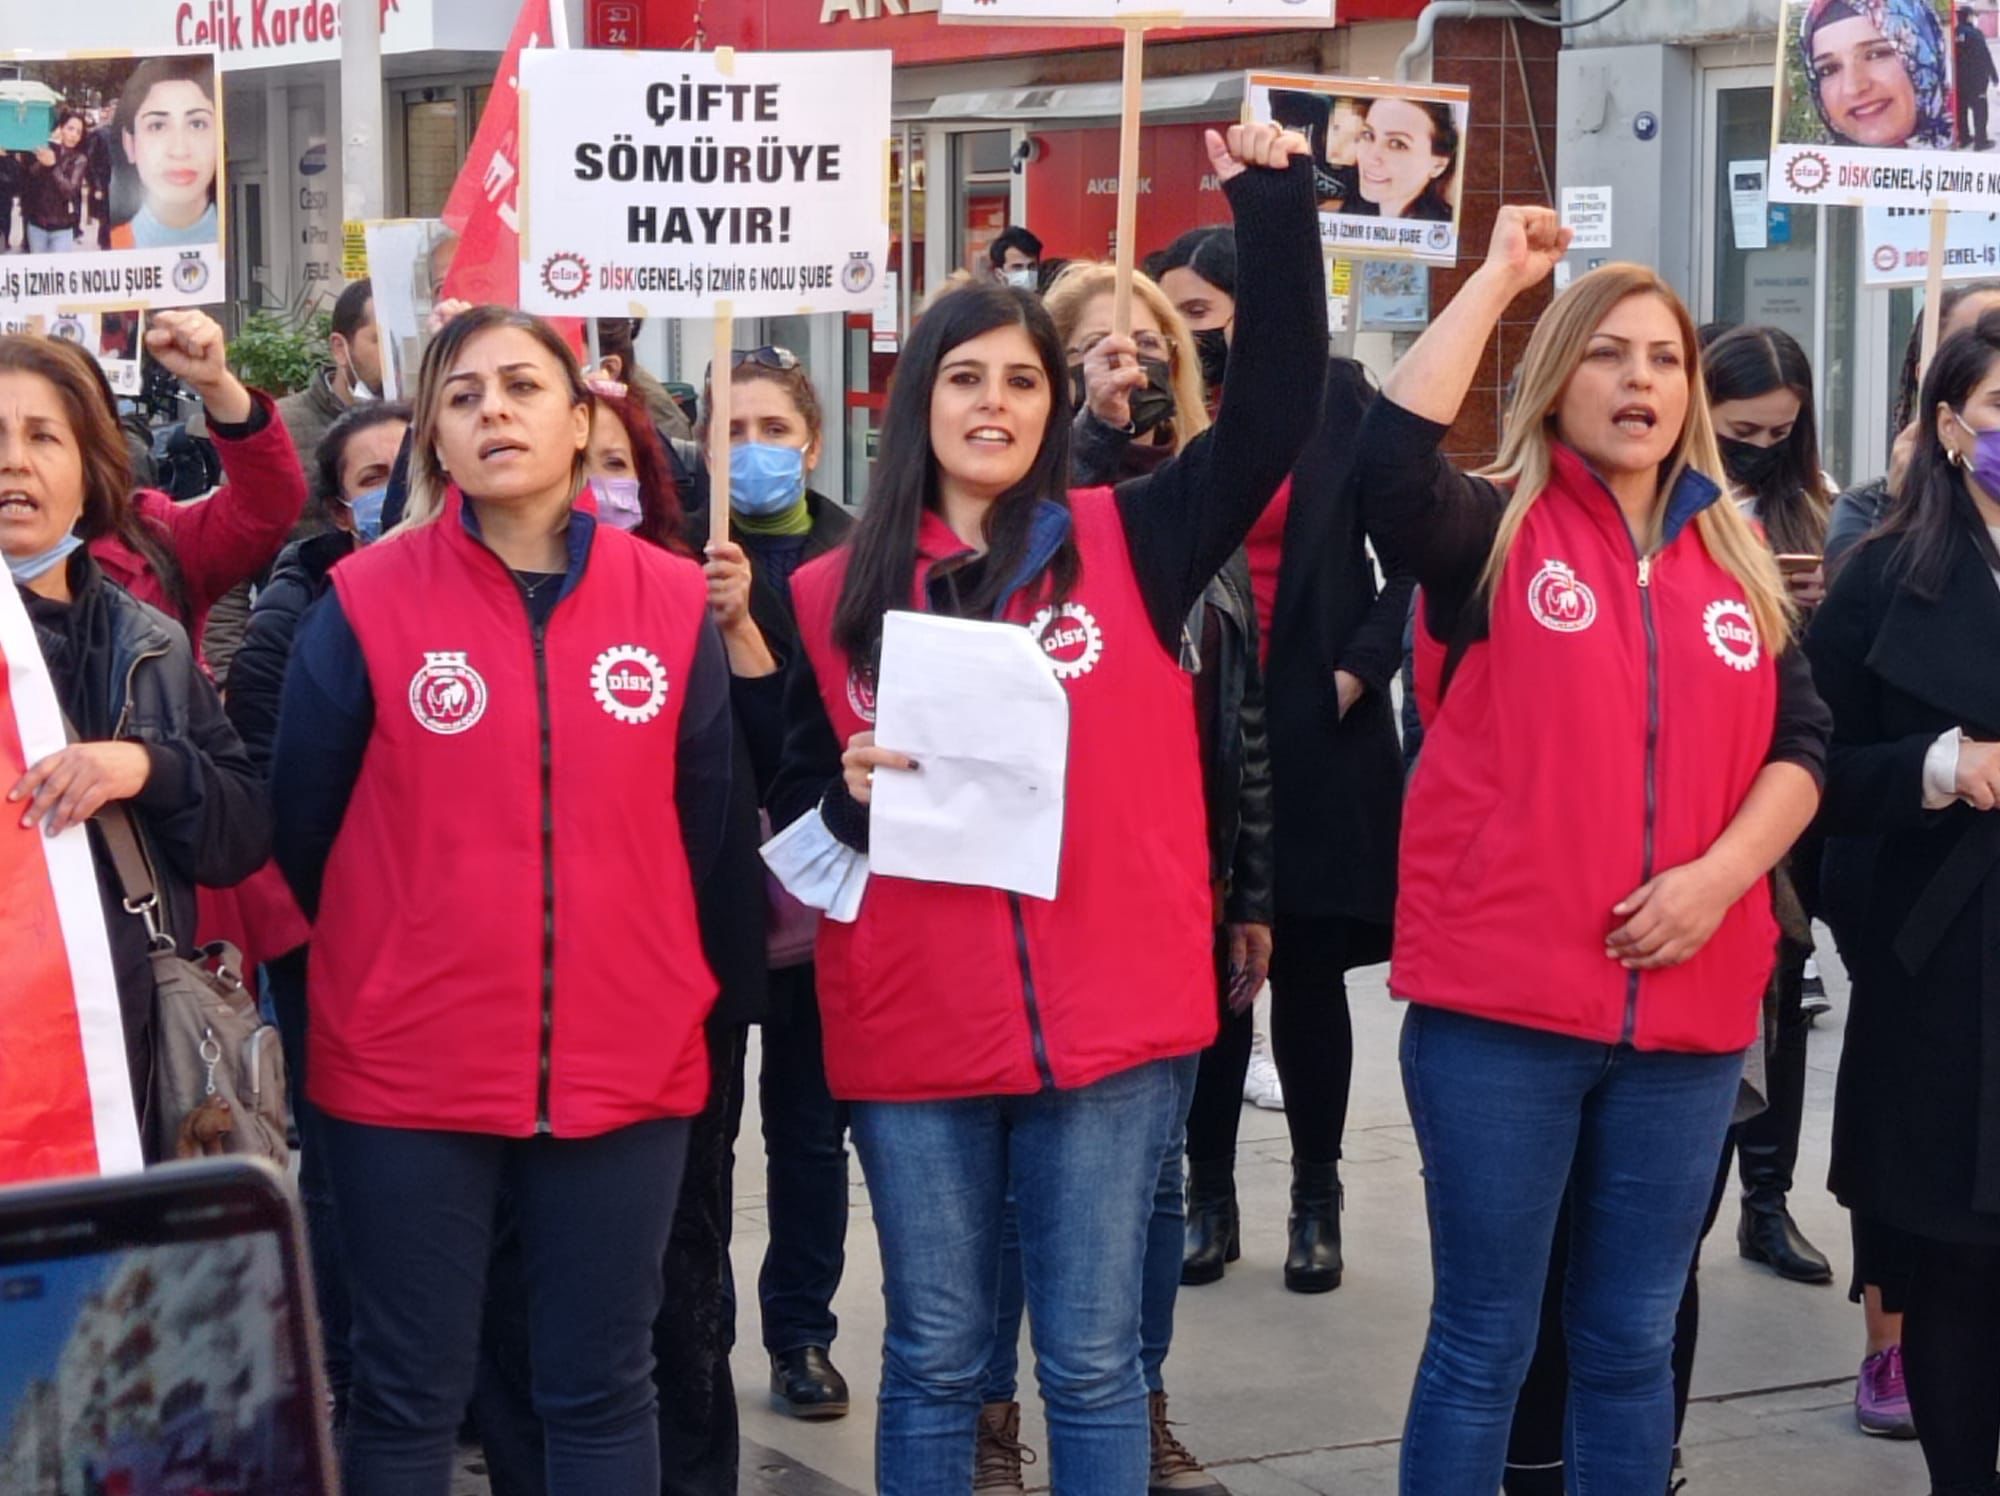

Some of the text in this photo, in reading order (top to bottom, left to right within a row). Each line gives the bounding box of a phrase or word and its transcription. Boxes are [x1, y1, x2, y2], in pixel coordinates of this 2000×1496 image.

[608, 28, 627, 43] 24
[646, 74, 779, 126] ÇİFTE
[574, 134, 840, 183] SÖMÜRÜYE
[1936, 164, 1973, 192] İZMİR
[1977, 172, 1984, 193] 6
[627, 206, 790, 244] HAYIR!
[24, 267, 65, 296] İZMİR
[69, 274, 77, 292] 6
[82, 269, 120, 295] NOLU
[125, 266, 162, 298] ŞUBE
[707, 263, 745, 293] İZMİR
[750, 268, 757, 291] 6
[761, 266, 795, 292] NOLU
[799, 265, 833, 295] ŞUBE
[608, 669, 651, 691] DİSK
